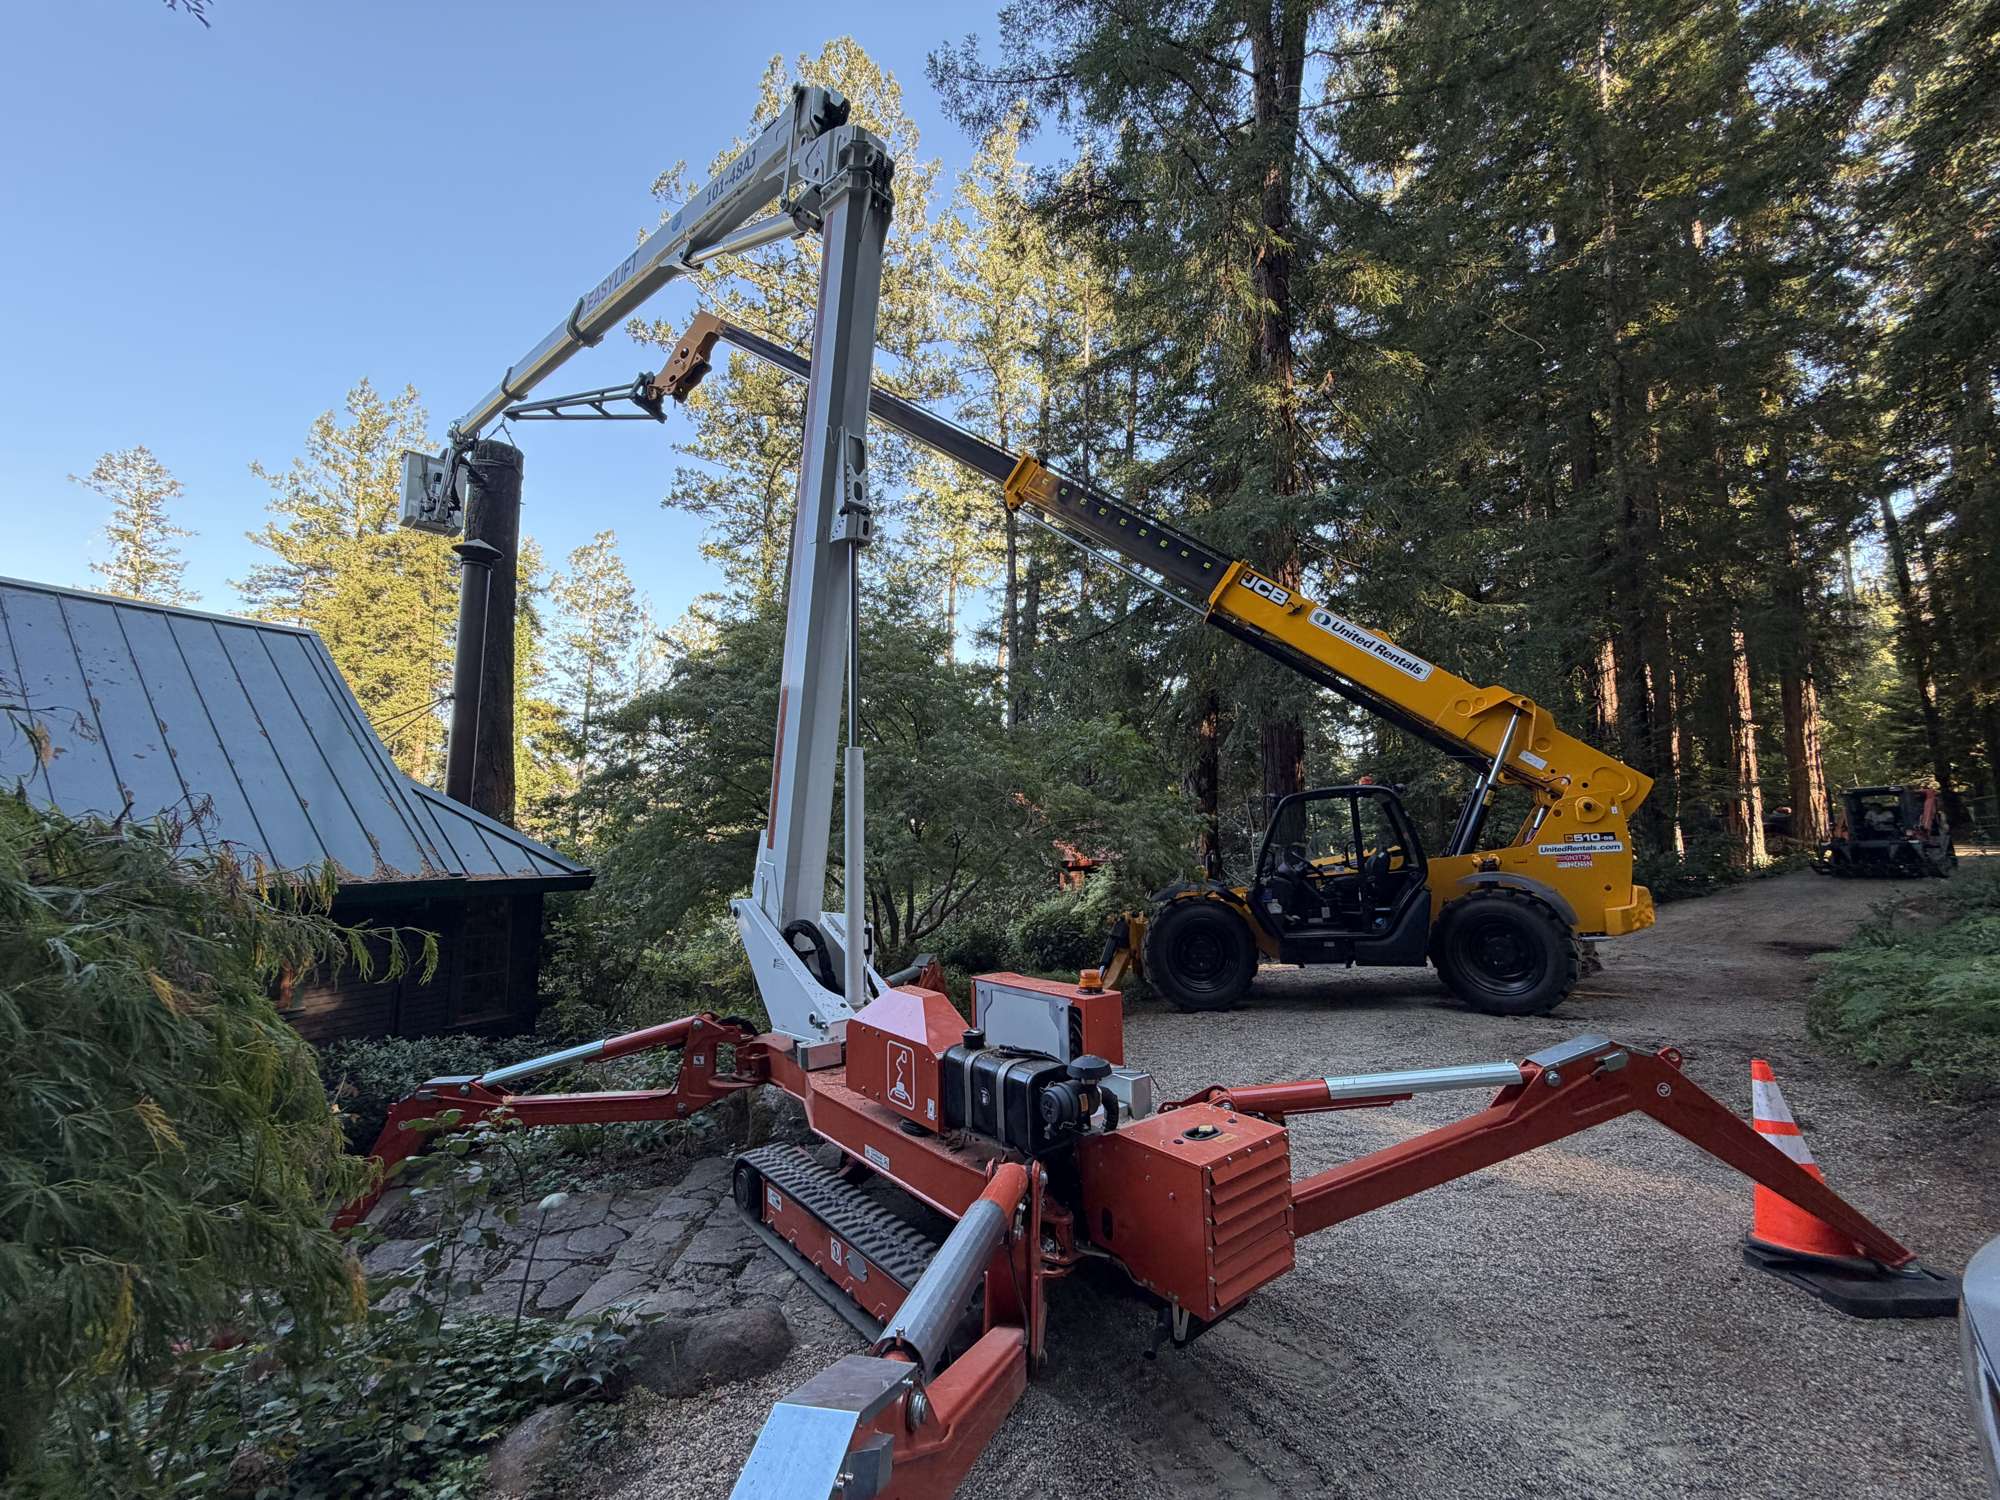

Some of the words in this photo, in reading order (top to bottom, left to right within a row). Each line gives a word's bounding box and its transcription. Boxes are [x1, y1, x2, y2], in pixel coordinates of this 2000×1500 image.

[586, 250, 640, 312] EASYLIFT
[1240, 574, 1290, 606] JCB
[1331, 621, 1374, 650] United
[1373, 643, 1424, 676] Rentals
